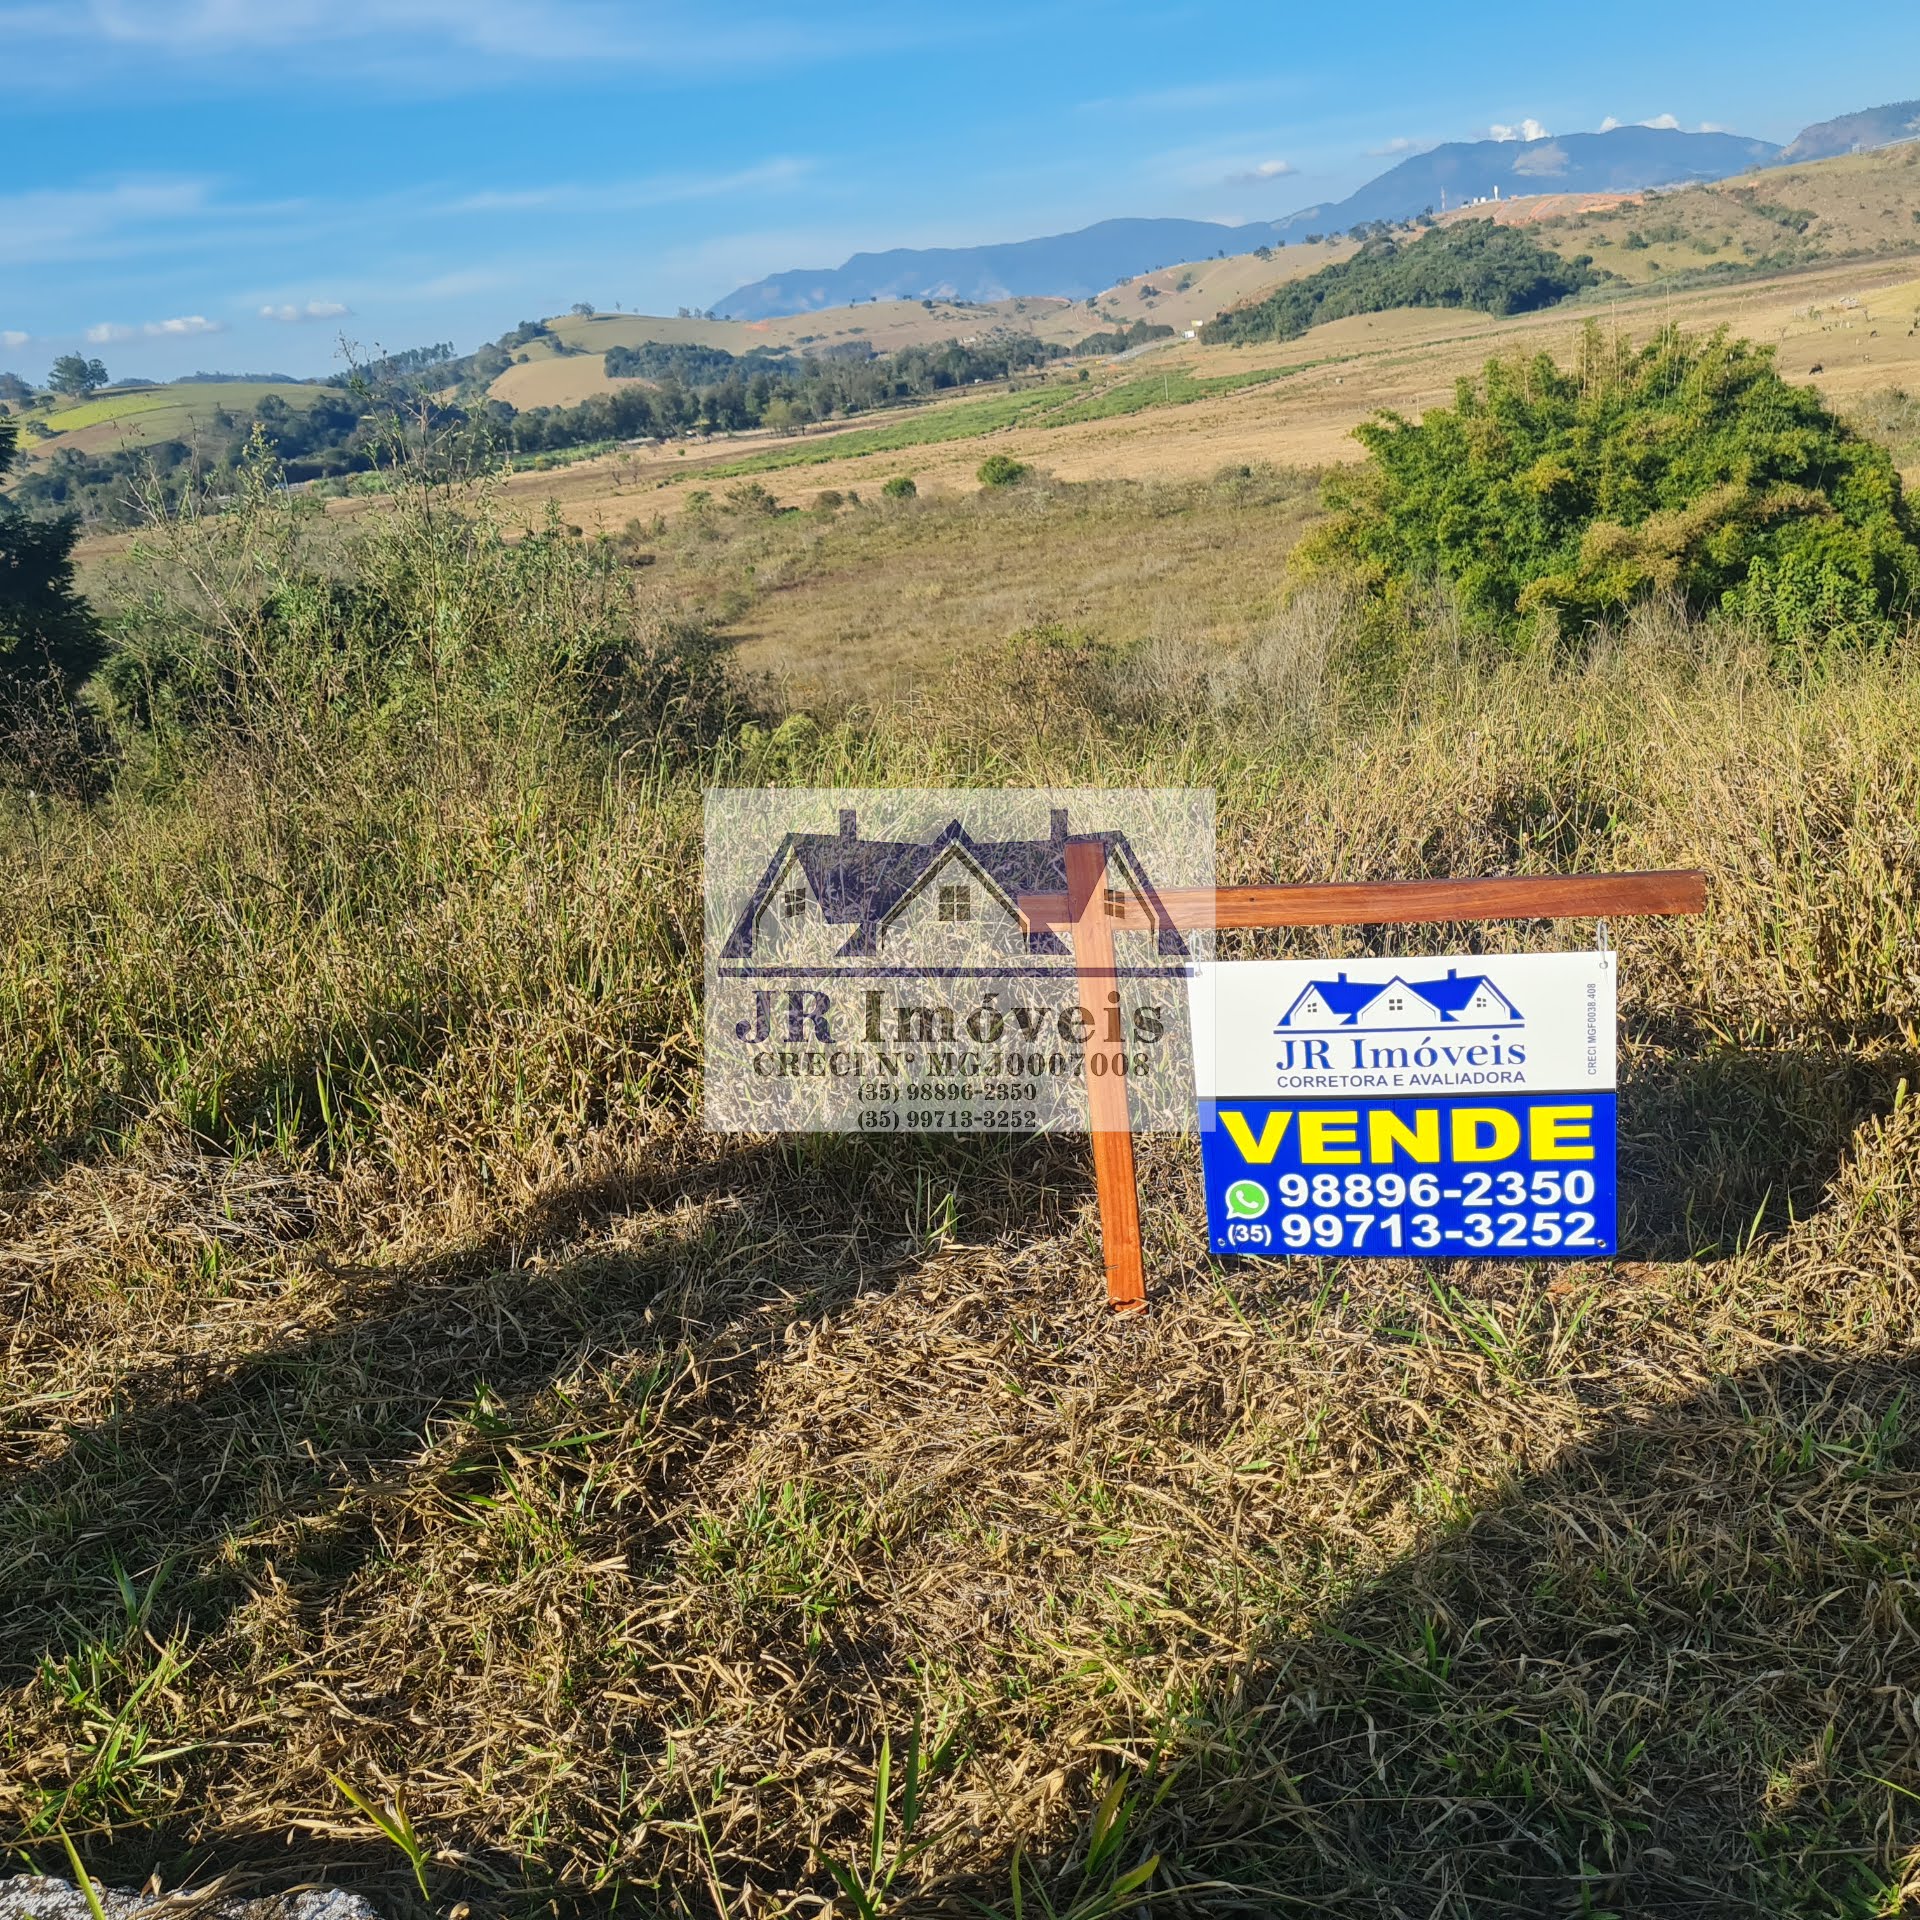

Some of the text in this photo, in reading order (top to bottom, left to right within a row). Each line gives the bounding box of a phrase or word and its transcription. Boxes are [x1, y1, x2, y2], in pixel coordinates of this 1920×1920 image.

[1275, 1034, 1527, 1071] JR Imóveis
[1587, 1046, 1597, 1076] CRECI
[1277, 1071, 1526, 1089] CORRETORA E AVALIADORA
[1218, 1105, 1595, 1164] VENDE
[1278, 1170, 1595, 1208] 98896-2350
[1227, 1211, 1597, 1249] (35) 99713-3252
